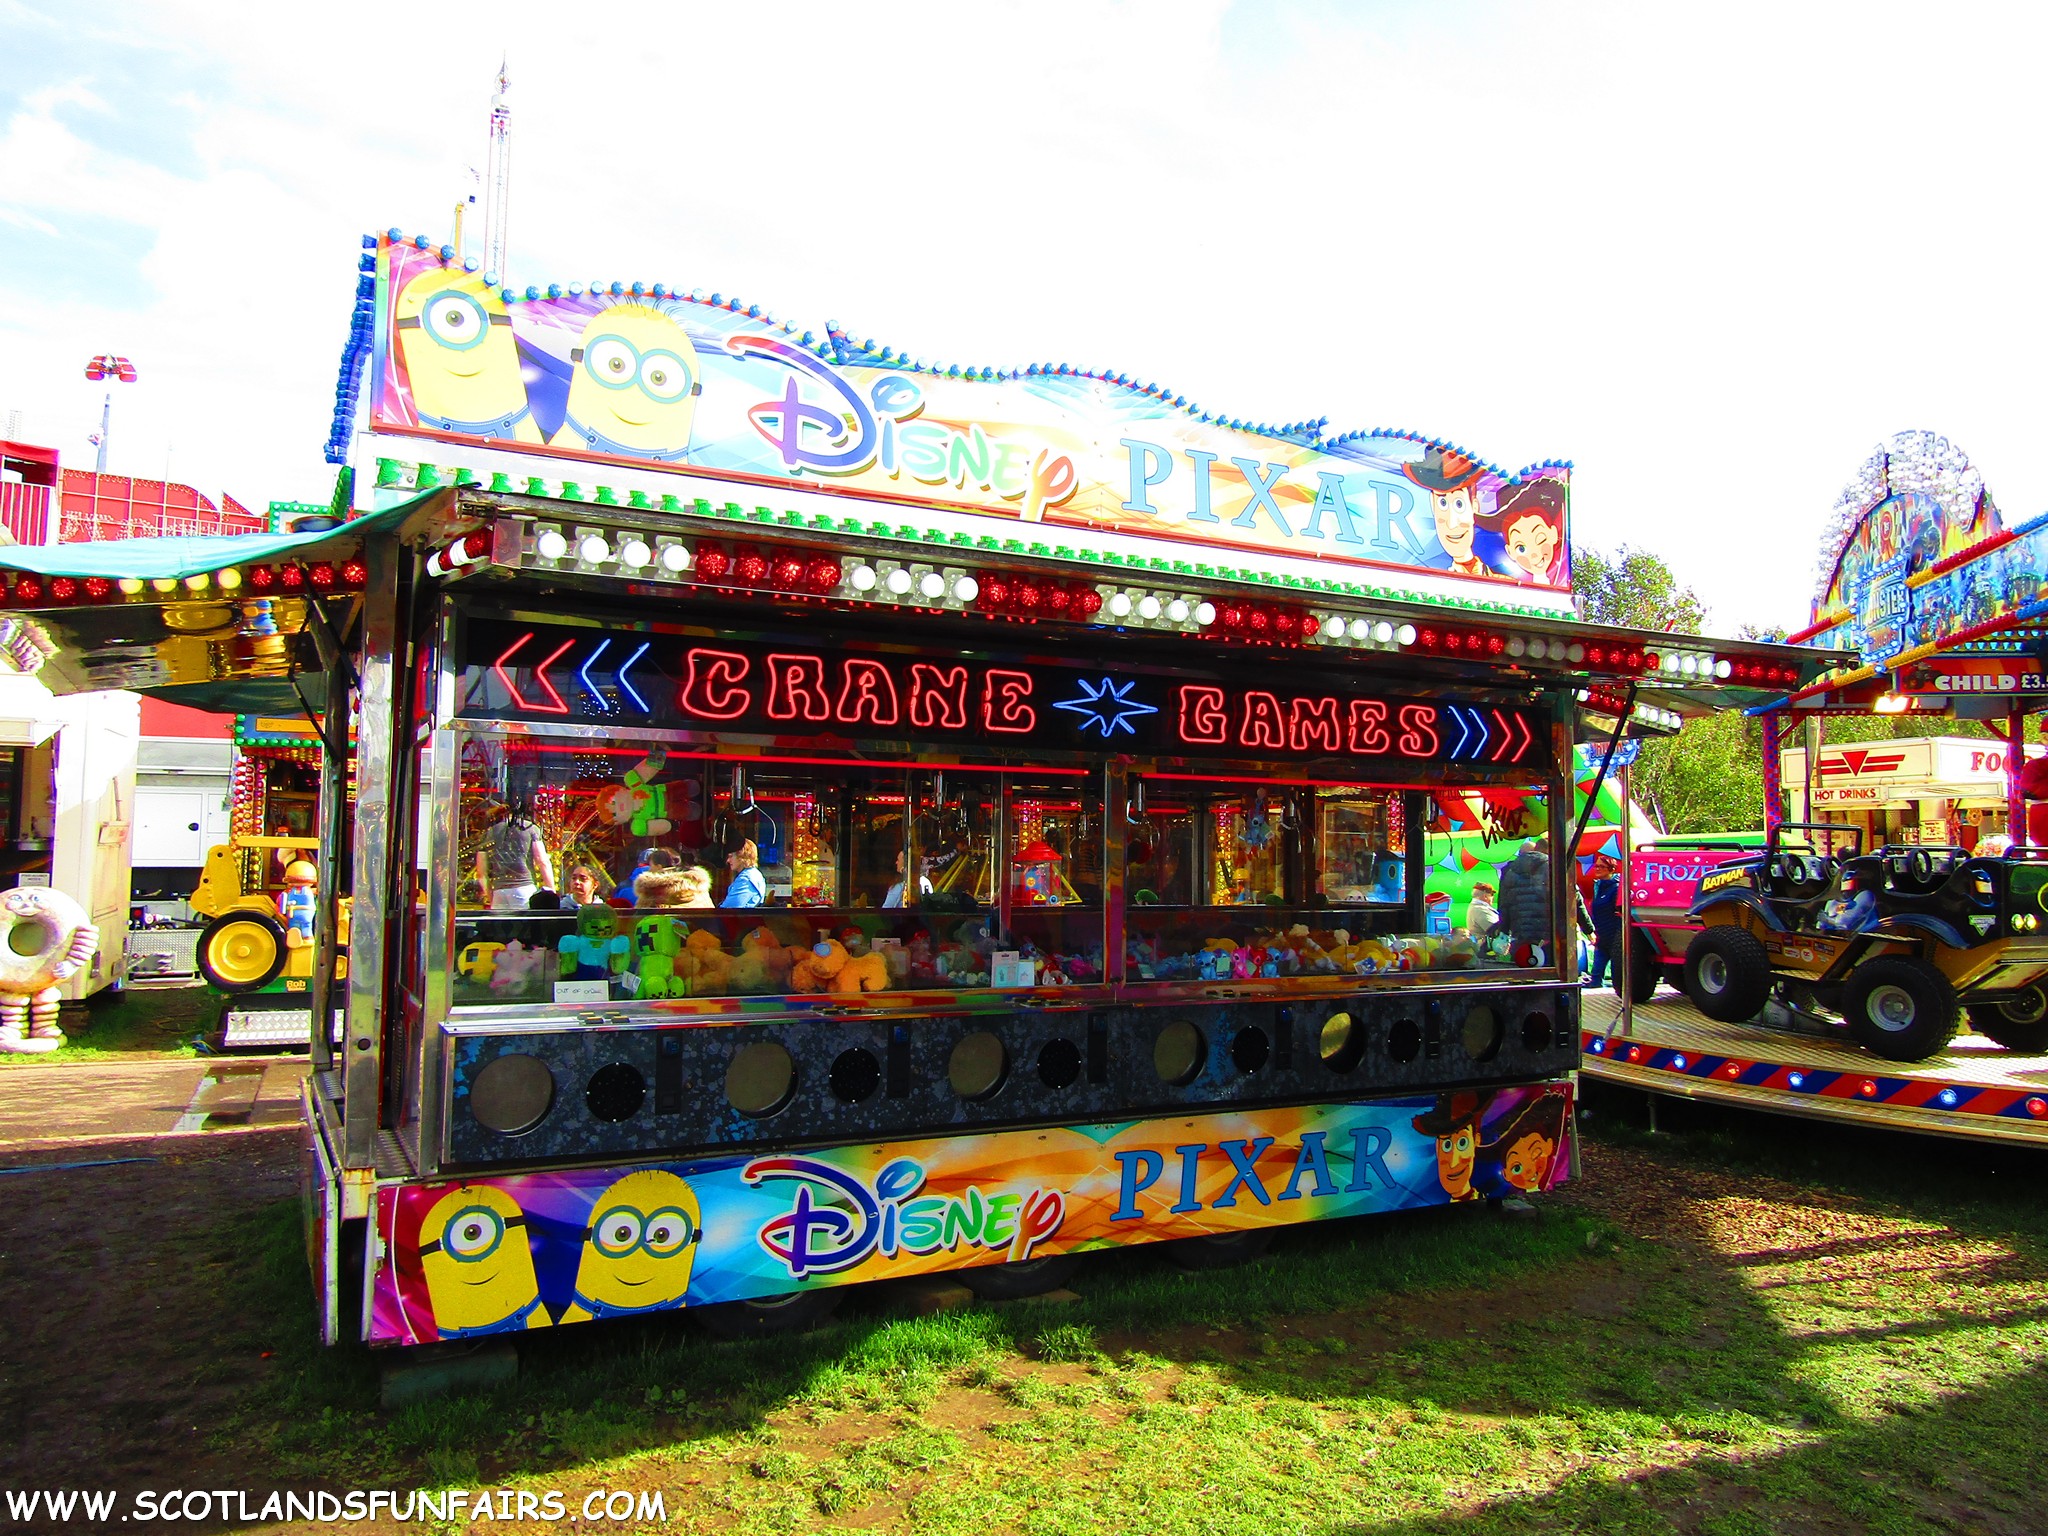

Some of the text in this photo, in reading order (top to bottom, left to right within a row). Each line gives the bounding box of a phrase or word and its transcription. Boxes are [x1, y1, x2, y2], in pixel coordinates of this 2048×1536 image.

[727, 335, 1425, 555] Disney PIXAR
[1934, 674, 2048, 691] CHILD £3.
[680, 646, 1441, 759] CRANE GAMES
[1814, 788, 1877, 801] HOT DRINKS
[1645, 862, 1718, 883] FROZE
[1701, 867, 1746, 892] BATMAN
[286, 980, 306, 989] Bob
[740, 1126, 1397, 1278] Disney PIXAR
